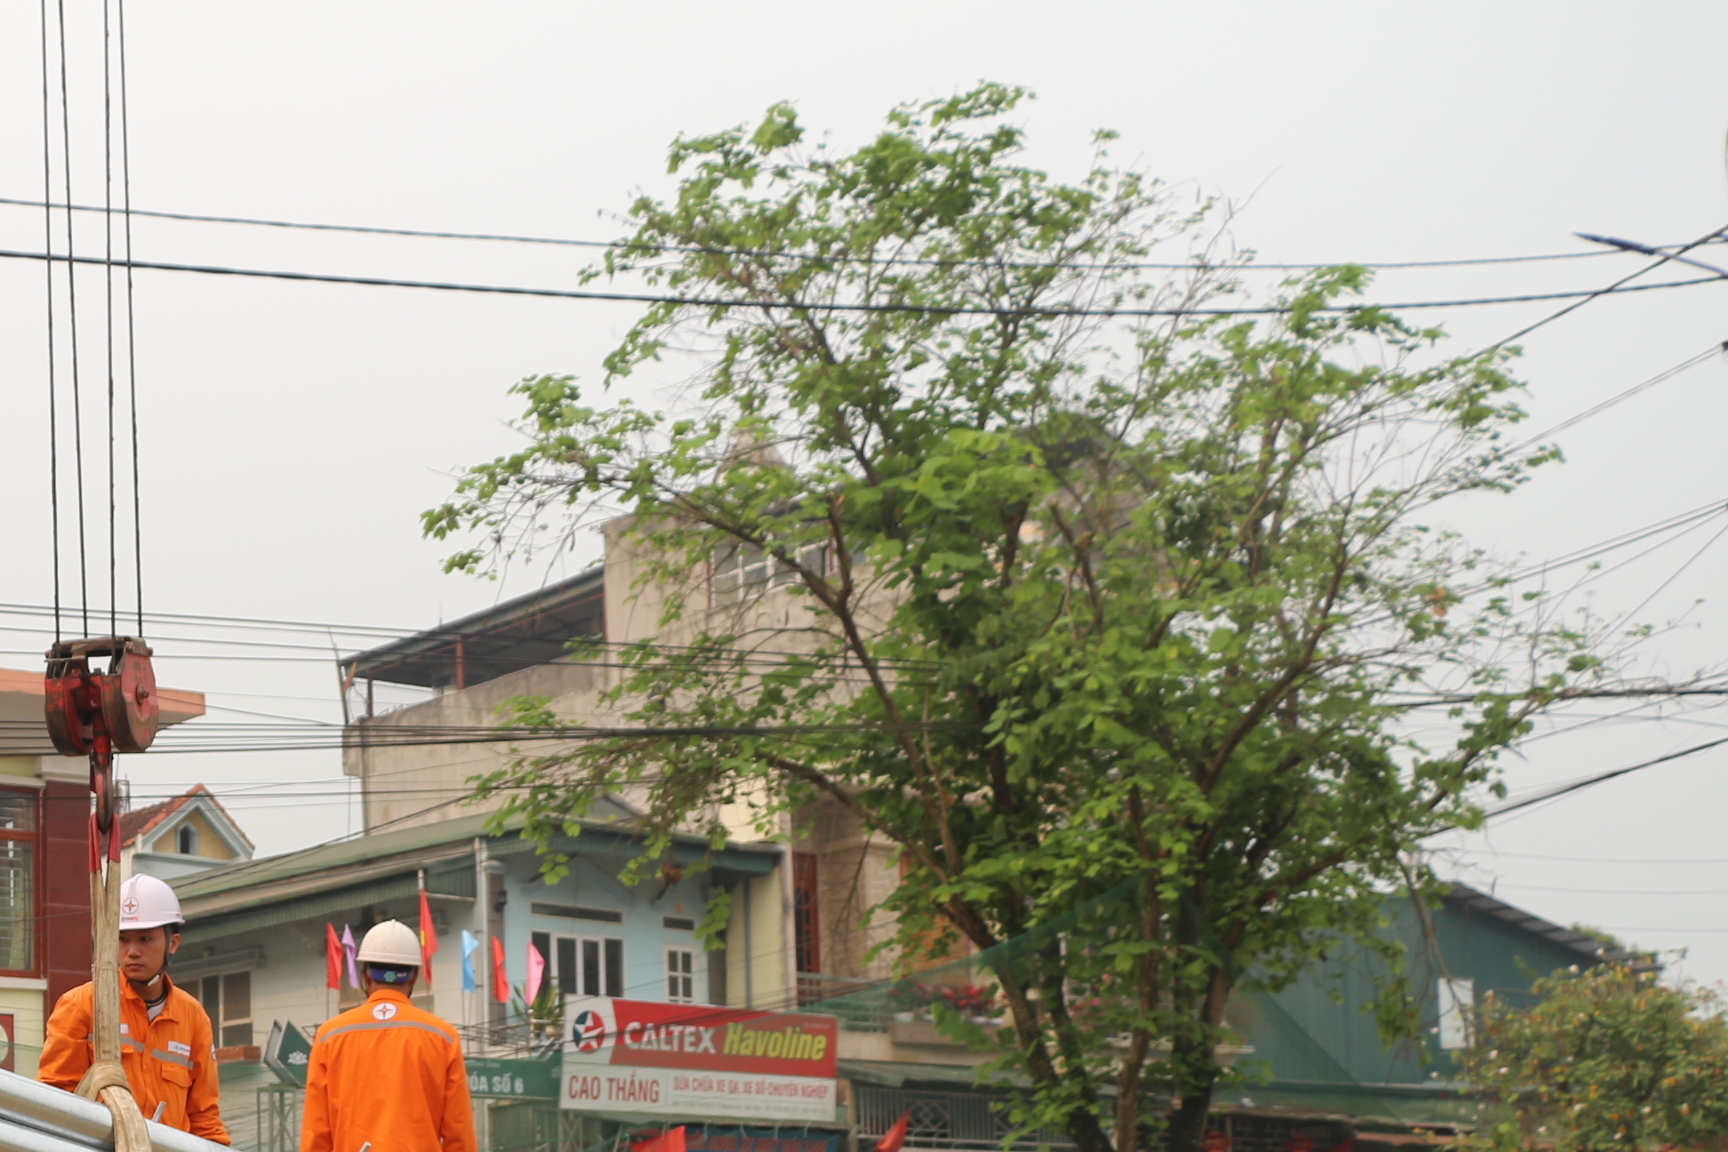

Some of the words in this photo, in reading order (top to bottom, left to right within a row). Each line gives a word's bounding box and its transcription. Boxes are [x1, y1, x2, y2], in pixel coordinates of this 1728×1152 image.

[624, 1020, 716, 1054] CALTEX
[723, 1021, 827, 1061] Havoline
[468, 1071, 489, 1092] ÓA
[492, 1072, 512, 1093] SỐ
[514, 1077, 525, 1094] 6
[568, 1074, 601, 1100] CAO
[607, 1069, 660, 1103] THẮNG
